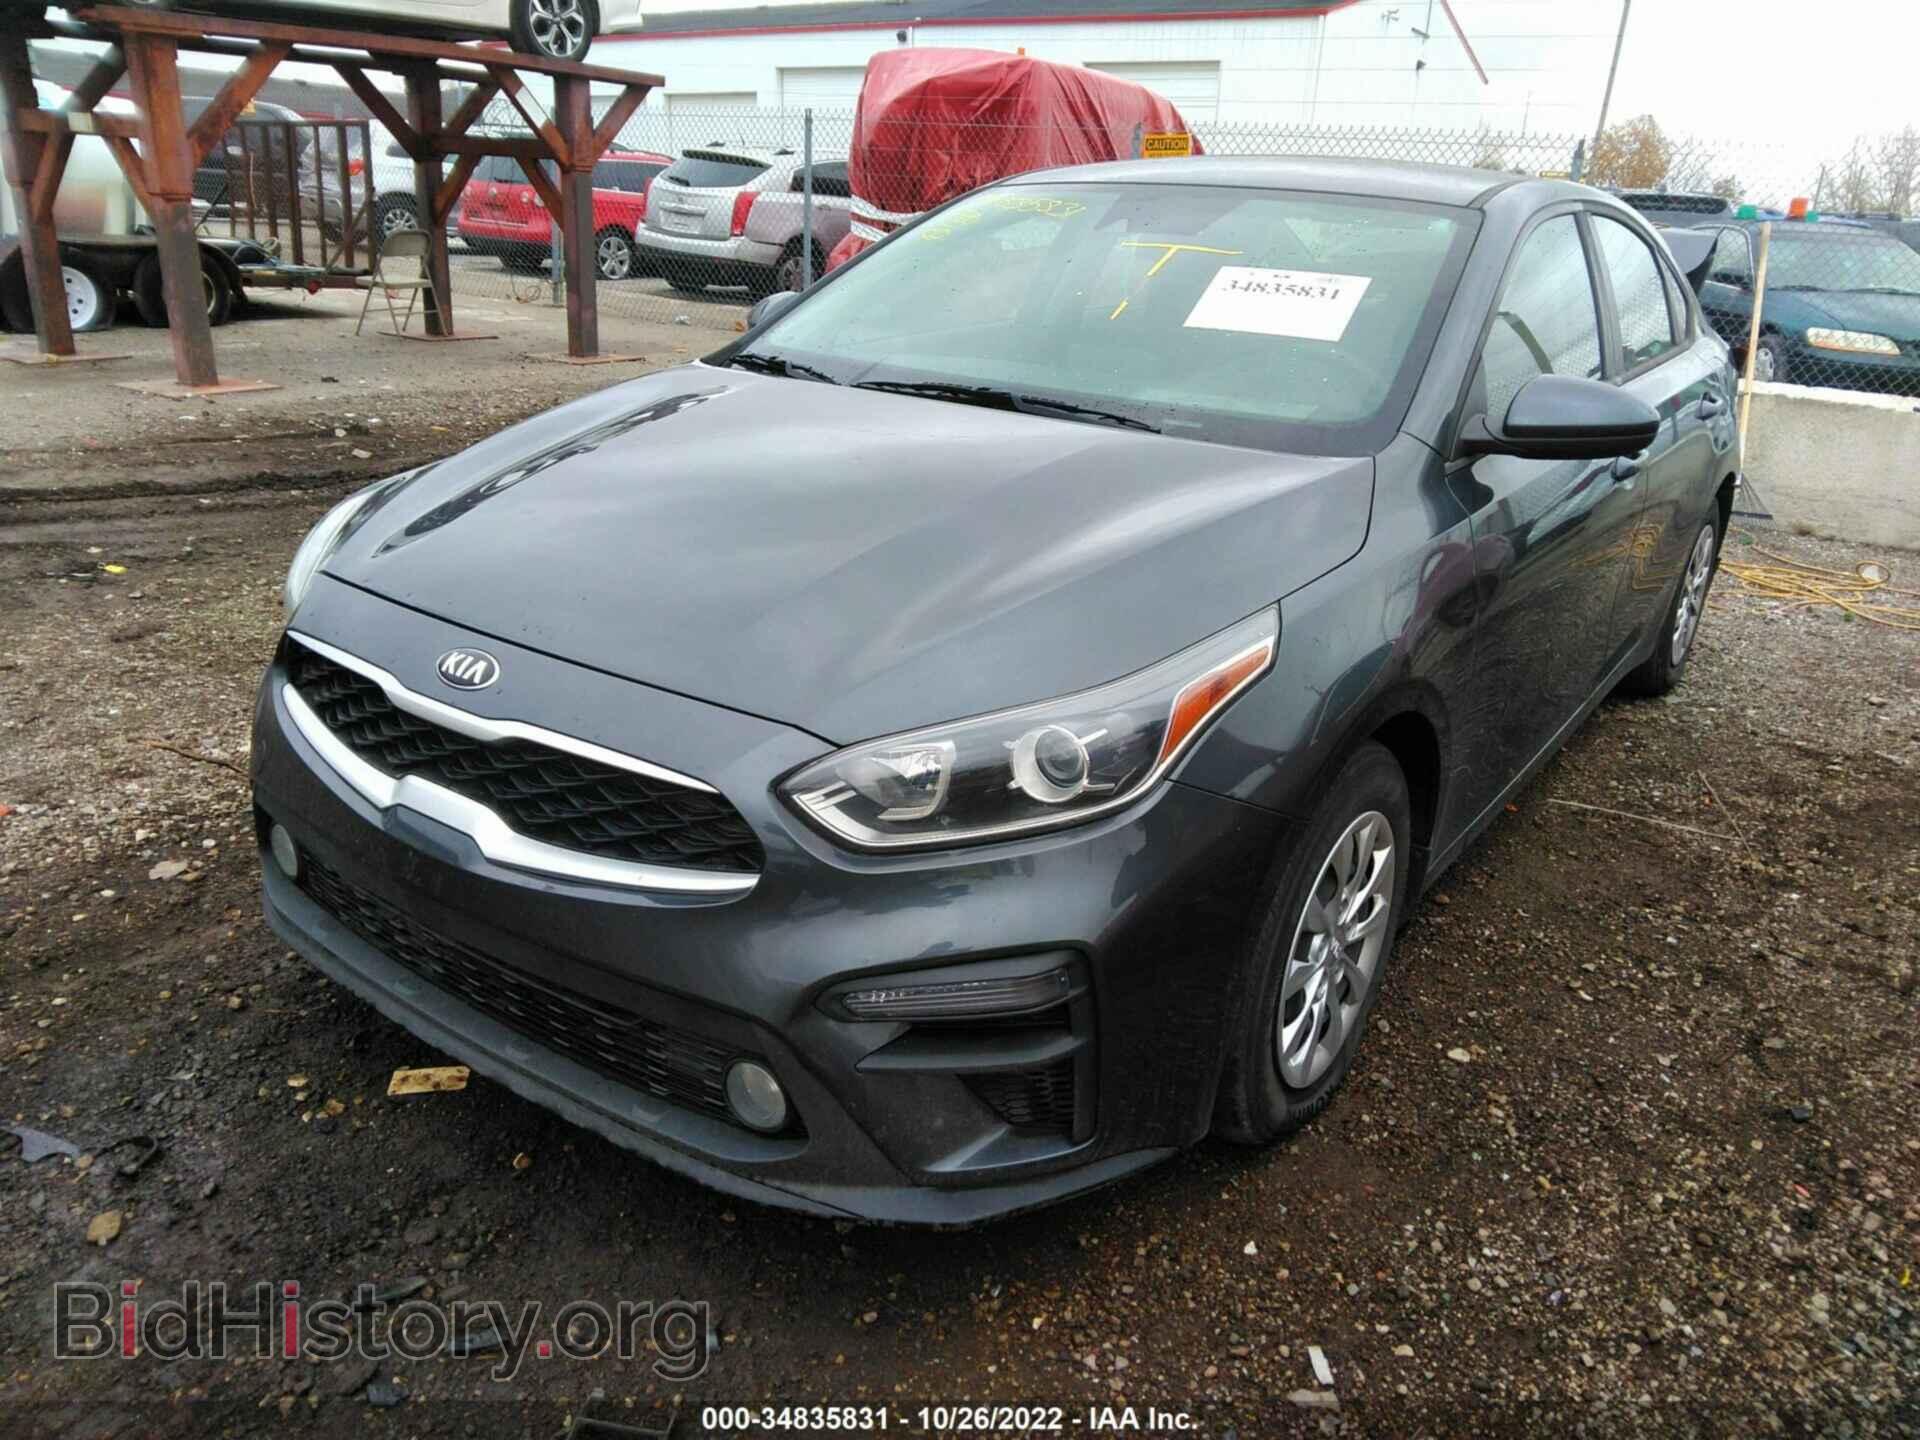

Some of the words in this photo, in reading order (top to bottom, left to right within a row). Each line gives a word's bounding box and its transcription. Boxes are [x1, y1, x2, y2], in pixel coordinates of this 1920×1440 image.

[1146, 138, 1188, 150] CAUTION
[1222, 279, 1341, 300] 34835831
[441, 651, 488, 684] KIA
